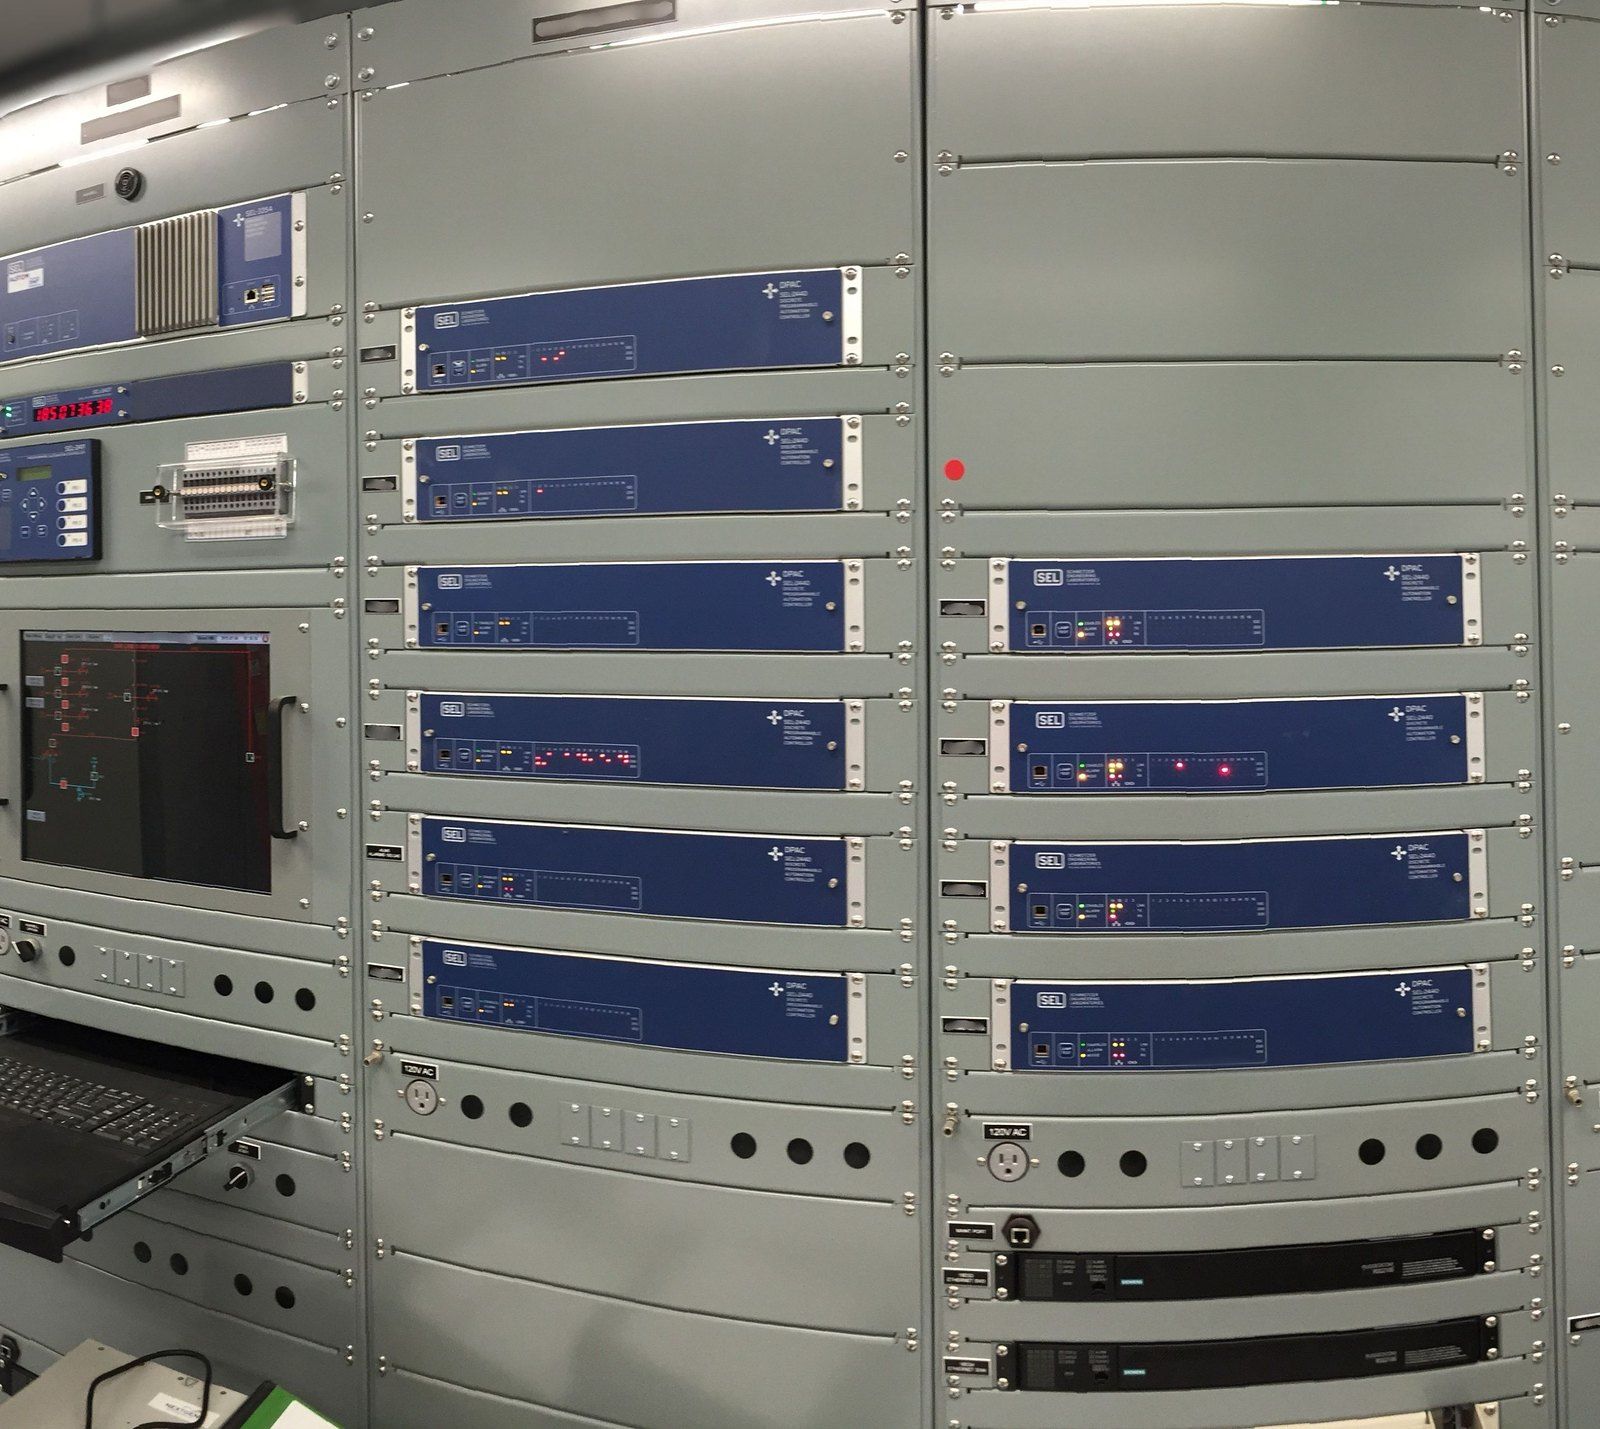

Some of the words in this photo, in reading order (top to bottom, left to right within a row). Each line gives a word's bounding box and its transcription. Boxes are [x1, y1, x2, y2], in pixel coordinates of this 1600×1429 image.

[436, 314, 457, 327] SEL
[438, 446, 458, 459] SEL
[439, 575, 460, 587] SEL
[1036, 571, 1060, 584] SEL
[441, 703, 462, 715] SEL
[1038, 714, 1062, 726] SEL
[443, 829, 464, 841] SEL
[1037, 854, 1062, 866] SEL
[444, 952, 465, 964] SEL
[1039, 994, 1063, 1006] SEL
[404, 1065, 422, 1074] 120V
[422, 1068, 434, 1076] AC
[989, 1128, 1012, 1136] 120V
[1012, 1128, 1028, 1136] AC
